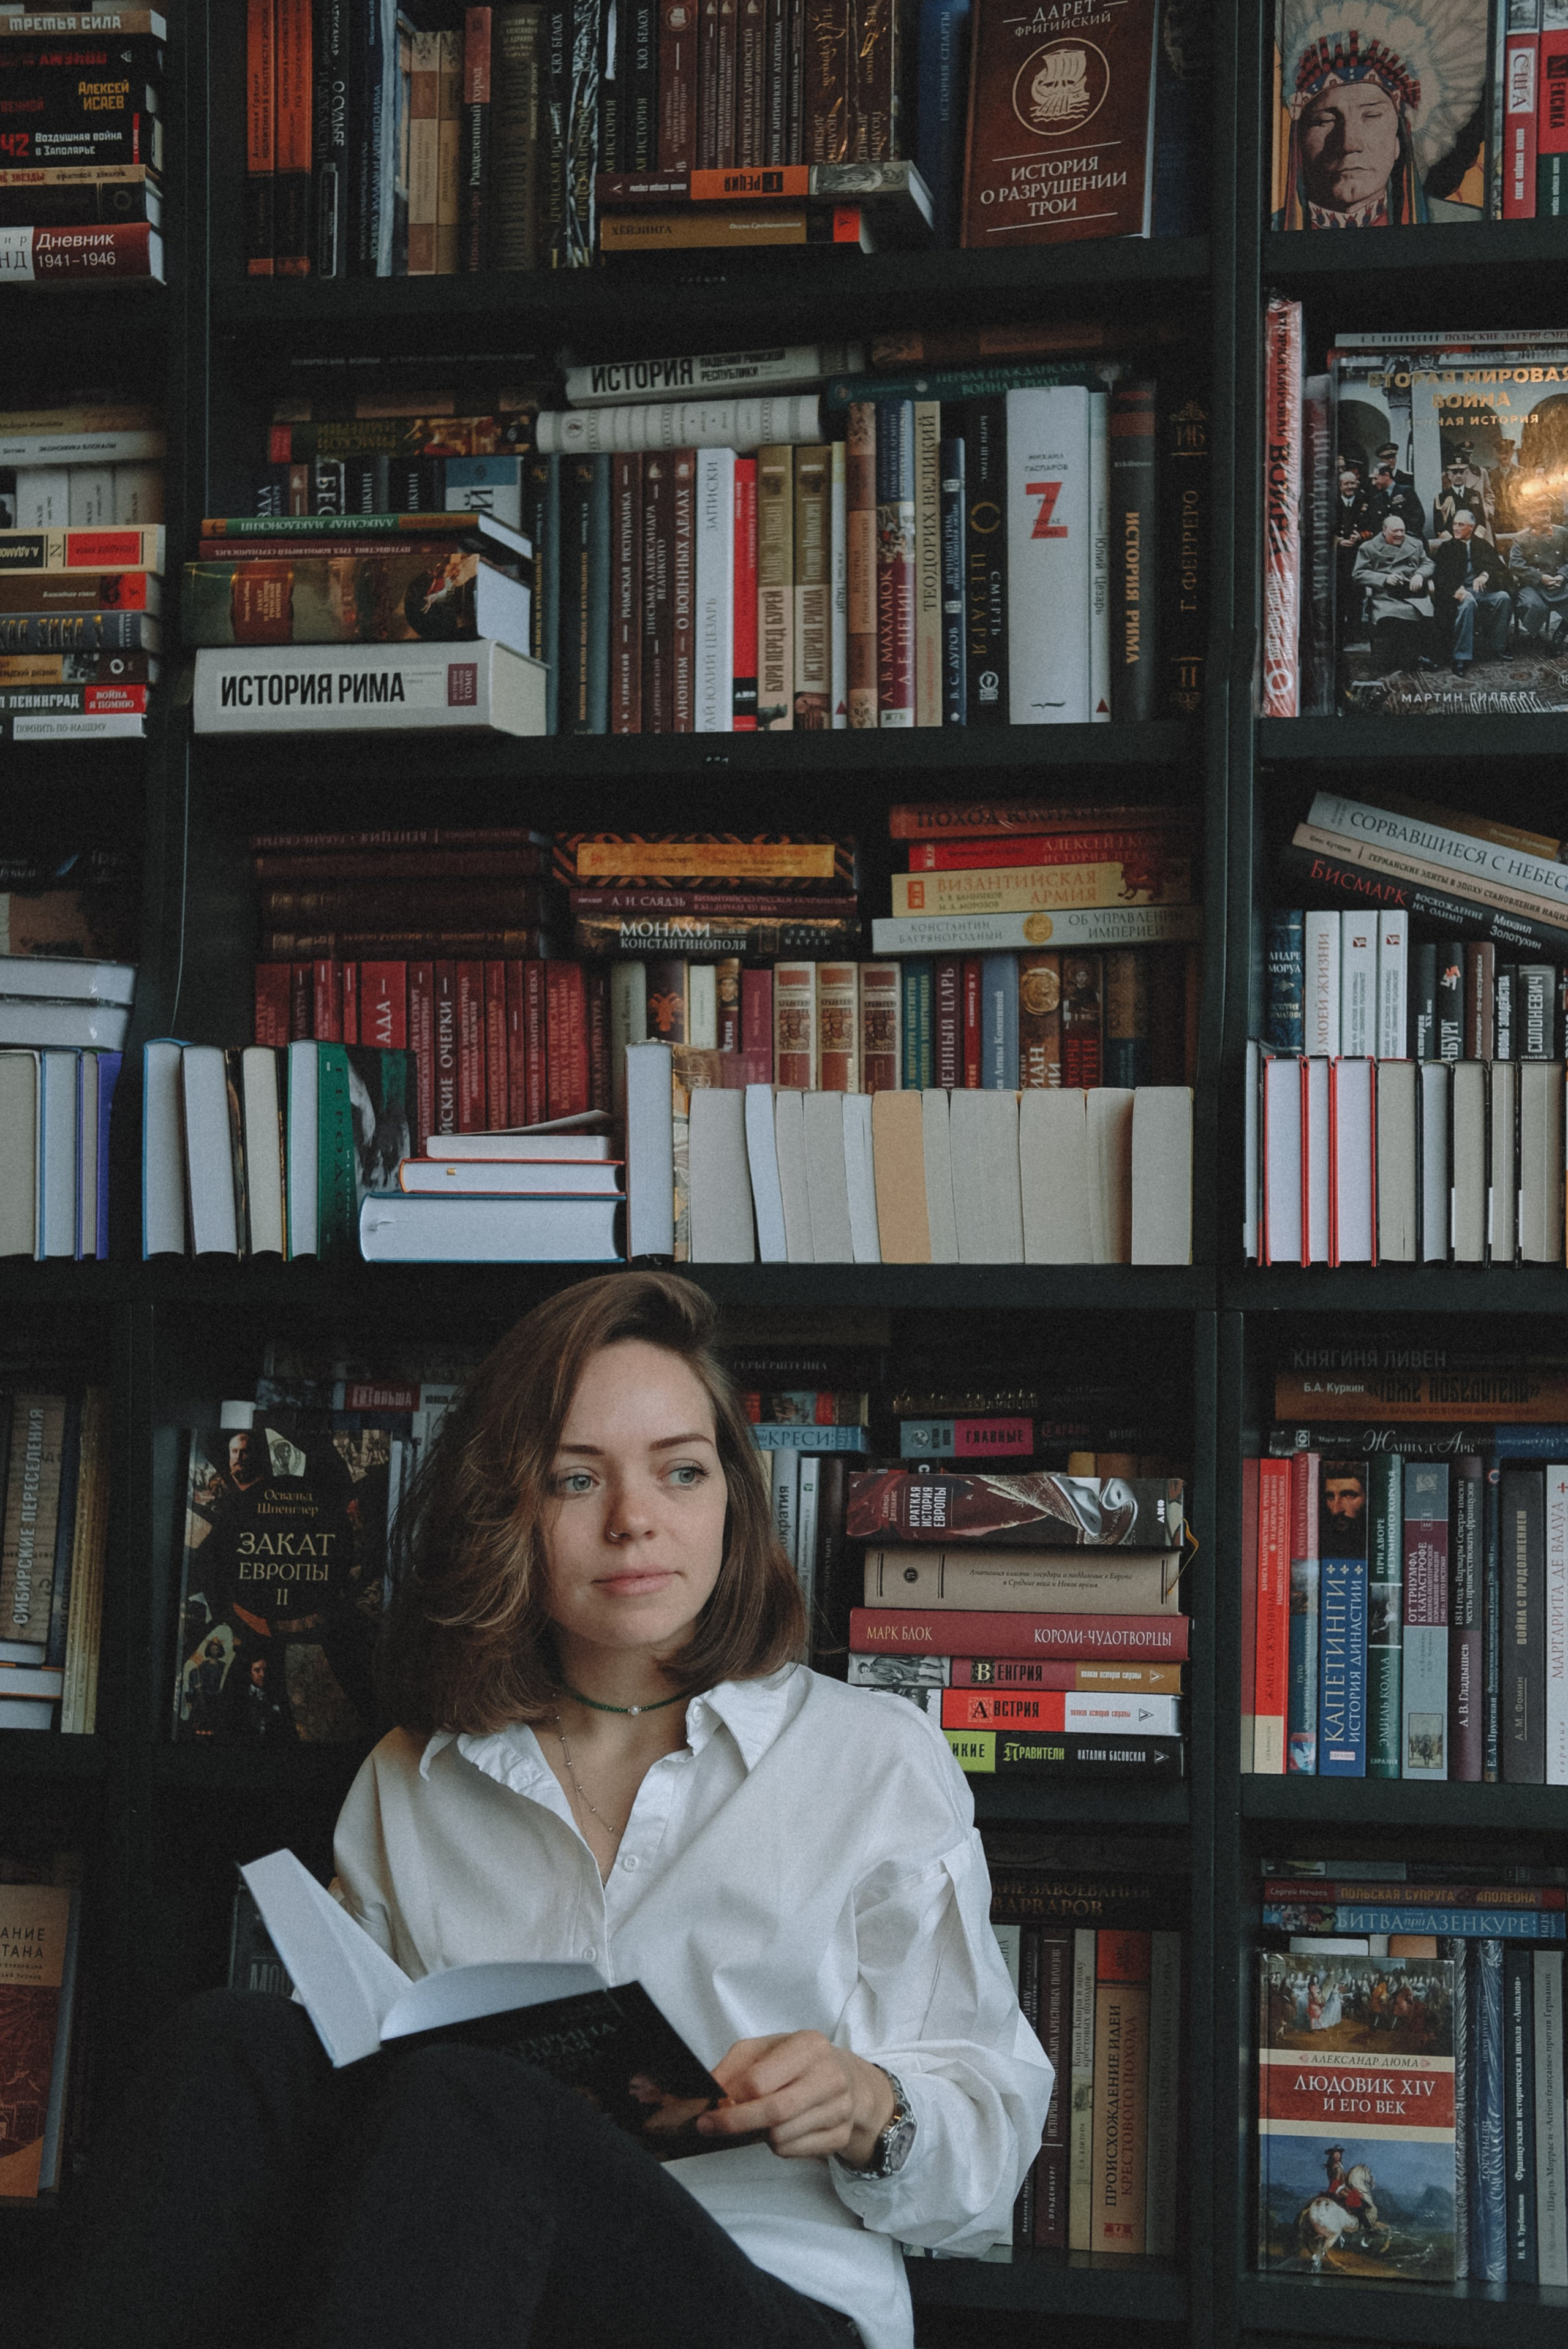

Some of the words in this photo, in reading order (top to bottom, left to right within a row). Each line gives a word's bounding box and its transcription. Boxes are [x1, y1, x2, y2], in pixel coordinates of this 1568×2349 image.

[10, 17, 76, 31] ТРЕТЬЯ
[81, 15, 121, 29] СИЛА
[637, 9, 649, 42] БЕЛОХ
[1015, 12, 1112, 37] ФРИГИЙСКИЙ
[1033, 0, 1097, 23] ДАРЕТ
[332, 81, 345, 91] О
[1512, 55, 1528, 109] США
[83, 96, 124, 110] ИСАЕВ
[331, 96, 344, 146] СУДЬБЕ
[1011, 156, 1099, 182] ИСТОРИЯ
[981, 188, 994, 205] О
[998, 172, 1128, 203] РАЗРУШЕНИИ
[1027, 195, 1077, 216] ТРОИ
[36, 233, 114, 250] Дневник
[591, 358, 694, 393] ИСТОРИЯ
[701, 366, 759, 382] РЕСПУБЛИКИ
[1368, 371, 1456, 388] ВТОРАЯ
[1432, 392, 1510, 408] ВОЙНА
[1470, 414, 1539, 426] ИСТОРИЯ
[919, 414, 937, 505] ВЕЛИКИЙ
[677, 489, 691, 537] ДЕЛАХ
[706, 461, 719, 532] ЗАПИСКИ
[1025, 482, 1068, 539] Z
[241, 520, 325, 531] МАКЕДОНСКИЙ
[330, 519, 394, 529] АЛЕКСАНДР
[1182, 490, 1199, 591] ФЕРРЕРО
[646, 504, 657, 580] АЛЕКСАНДРА
[1095, 538, 1107, 569] Юлий
[1125, 512, 1140, 599] ИСТОРИЯ
[657, 539, 667, 599] ВЕЛИКОГО
[677, 541, 690, 613] ВОЕННЫХ
[923, 512, 939, 611] ТЕОДОРИХ
[647, 585, 657, 634] ПИСЬМА
[764, 591, 784, 624] БУРЕЙ
[803, 589, 824, 624] РИМА
[971, 553, 987, 654] ЦЕЗАРЯ
[991, 572, 1001, 635] СМЕРТЬ
[1095, 576, 1107, 615] Цезарь
[677, 618, 690, 629] О
[704, 598, 718, 649] ЦЕЗАРЬ
[1126, 608, 1140, 664] РИМА
[766, 628, 786, 662] ПЕРЕД
[804, 629, 824, 681] ИСТОРИЯ
[221, 673, 331, 706] ИСТОРИЯ
[338, 672, 405, 703] РИМА
[677, 657, 689, 719] АНОНИМ
[703, 654, 717, 700] ЮЛИЙ
[766, 665, 784, 692] БУРЯ
[9, 694, 80, 708] ЛЕНИНГРАД
[96, 690, 127, 699] ВОЙНА
[98, 700, 134, 709] ПОМНЮ
[1402, 692, 1463, 703] МАРТИН
[1470, 691, 1536, 703] ГИЛБЕРТ
[1351, 812, 1487, 865] СОРВАВШИЕСЯ
[1491, 856, 1503, 870] С
[1508, 859, 1567, 891] НЕБЕС
[937, 870, 1096, 893] ВИЗАНТИЙСКАЯ
[1030, 889, 1097, 905] АРМИЯ
[1311, 859, 1409, 906] БИСМАРК
[959, 901, 1000, 910] МОРОЗОВ
[1068, 914, 1088, 926] ОБ
[1415, 893, 1483, 920] ВОСХОЖДЕНИЕ
[619, 922, 710, 937] МОНАХИ
[899, 931, 1003, 944] БАГРЯНОРОДНЫЙ
[910, 920, 990, 931] КОНСТАНТИН
[1088, 925, 1163, 939] ИМПЕРИЕЙ
[1489, 925, 1542, 950] Золотухин
[1493, 913, 1532, 934] Михаил
[620, 939, 747, 950] КОНСТАНТИНОПОЛЯ
[1269, 951, 1300, 961] АНДРЕ
[1268, 964, 1301, 974] МОРУА
[1317, 933, 1329, 995] ЖИЗНИ
[941, 967, 955, 1011] ЦАРЬ
[1528, 975, 1544, 1053] СОЛОНЕВИЧ
[440, 1001, 453, 1069] ОЧЕРКИ
[1294, 1350, 1378, 1367] КНЯГИНЯ
[1383, 1351, 1446, 1368] ЛИВЕН
[1304, 1383, 1324, 1393] Б.А.
[1327, 1383, 1364, 1394] Куркин
[768, 1431, 831, 1445] КРЕСИ
[966, 1429, 1023, 1443] ГЛАВНЫЕ
[22, 1408, 44, 1523] ПЕРЕСЕЛЕНИЯ
[264, 1489, 313, 1502] Освальд
[910, 1486, 921, 1527] КРАТКАЯ
[922, 1486, 933, 1527] ИСТОРИЯ
[934, 1487, 946, 1527] ЕВРОПЫ
[1388, 1470, 1396, 1511] КОРОЛЯ
[257, 1503, 318, 1516] Шпенглер
[1376, 1518, 1386, 1555] ДВОРЕ
[1551, 1502, 1564, 1552] ВАЛУА
[236, 1532, 336, 1556] ЗАКАТ
[1387, 1514, 1396, 1574] БЕЗУМНОГО
[1516, 1510, 1527, 1597] ПРОДОЛЖЕНИЕМ
[13, 1528, 36, 1625] СИБИРСКИЕ
[239, 1563, 329, 1580] ЕВРОПЫ
[1376, 1557, 1385, 1574] ПРИ
[1408, 1551, 1418, 1604] ТРИУМФА
[1551, 1559, 1565, 1578] ДЕ
[1350, 1579, 1363, 1665] ДИНАСТИИ
[1408, 1608, 1418, 1622] ОТ
[1516, 1610, 1527, 1644] ВОЙНА
[867, 1626, 899, 1641] МАРК
[902, 1627, 932, 1641] БЛОК
[1034, 1629, 1172, 1647] КОРОЛИ-ЧУДОТВОРЦЫ
[1551, 1587, 1564, 1679] МАРГАРИТА
[1325, 1579, 1345, 1742] КАПЕТИНГИ
[1380, 1657, 1390, 1698] КОЛЛА
[968, 1697, 1039, 1723] АВСТРИЯ
[1349, 1671, 1362, 1742] ИСТОРИЯ
[1514, 1677, 1524, 1712] Фомин
[1379, 1702, 1390, 1746] ЭМИЛЬ
[1077, 1749, 1106, 1761] НАТАЛИЯ
[1109, 1750, 1146, 1763] БАСОВСКАЯ
[1341, 1888, 1400, 1899] ПОЛЬСКАЯ
[1404, 1888, 1455, 1901] СУПРУГА
[1338, 1913, 1403, 1928] БИТВА
[1426, 1918, 1528, 1934] АЗЕНКУРЕ
[1109, 2005, 1121, 2049] ИДЕИ
[1514, 2026, 1523, 2054] школа
[1123, 2016, 1137, 2084] ПОХОДА
[1311, 2054, 1379, 2066] АЛЕКСАНДР
[1381, 2057, 1419, 2068] ДЮМА
[1294, 2075, 1395, 2097] ЛЮДОВИК
[1401, 2079, 1436, 2097] XIV
[1514, 2057, 1523, 2117] историческая
[1323, 2098, 1336, 2112] И
[1340, 2098, 1371, 2113] ЕГО
[1376, 2100, 1406, 2115] ВЕК
[1105, 2053, 1121, 2207] ПРОИСХОЖДЕНИЕ
[1121, 2087, 1135, 2196] КРЕСТОВОГО
[1513, 2120, 1525, 2181] Французская
